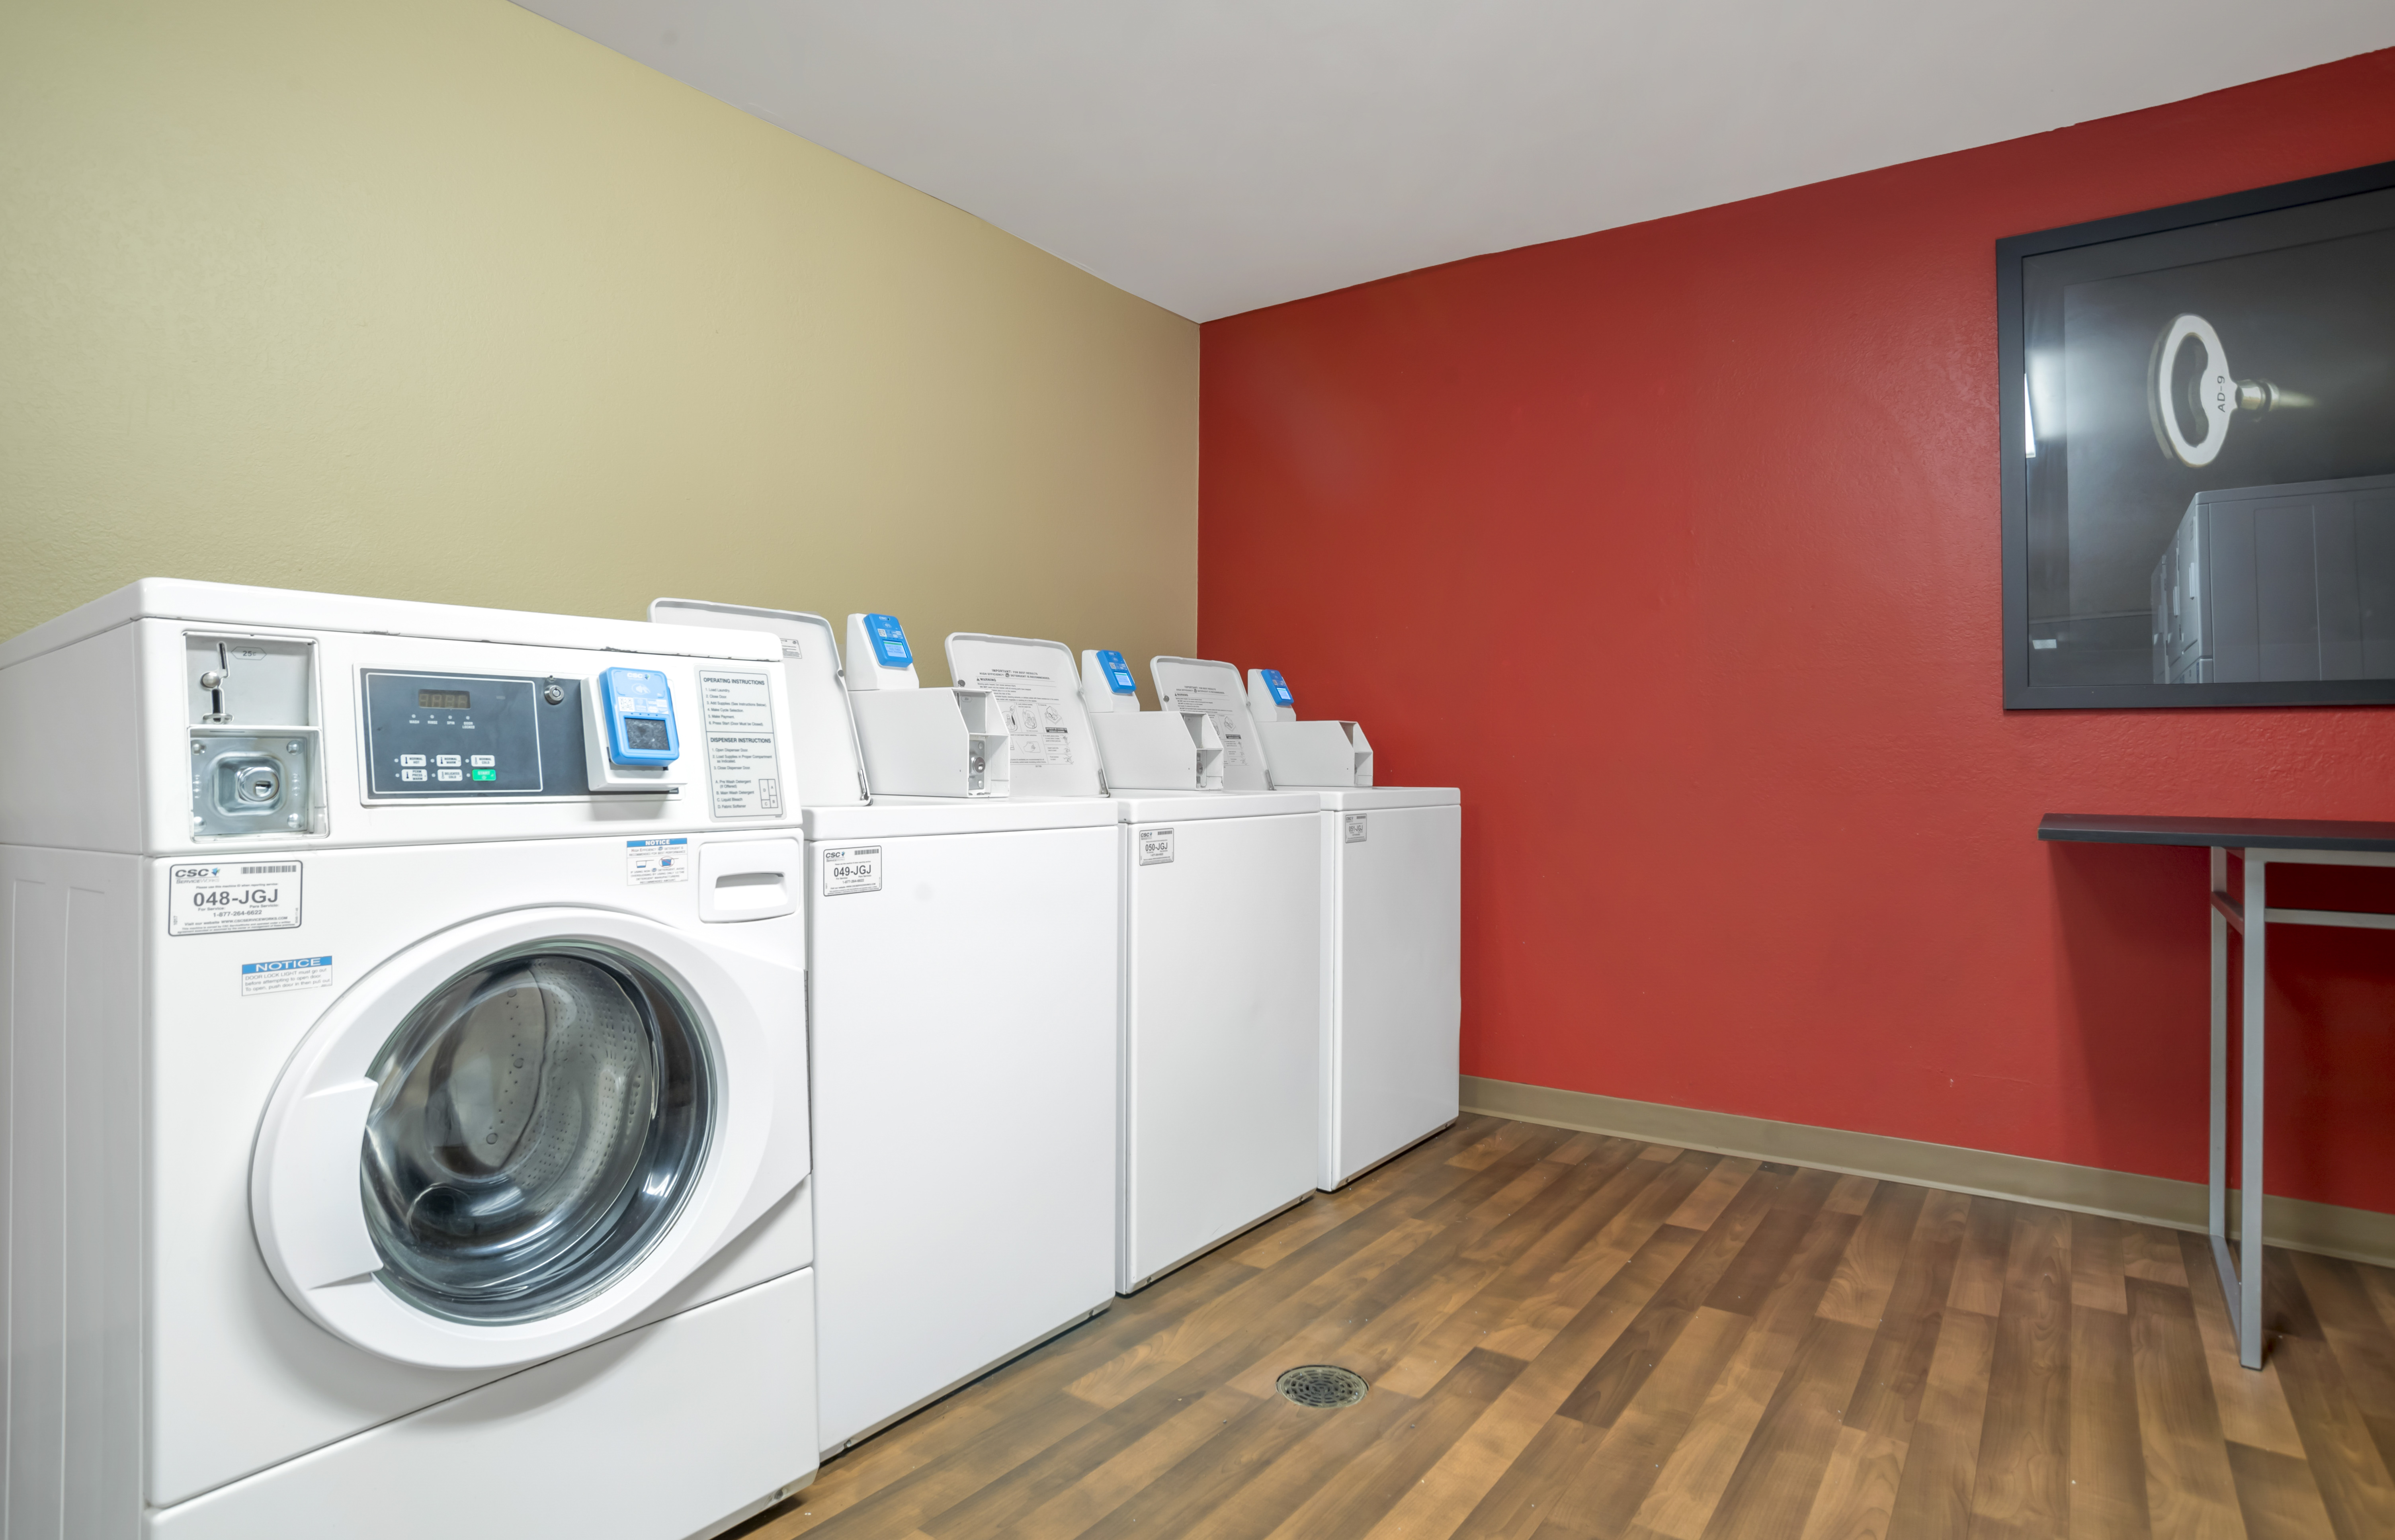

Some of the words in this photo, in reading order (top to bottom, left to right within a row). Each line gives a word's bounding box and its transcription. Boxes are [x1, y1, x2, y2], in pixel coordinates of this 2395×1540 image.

[2217, 375, 2225, 412] AD-9
[1145, 842, 1168, 851] 050-JGJ
[175, 869, 209, 877] CSC
[834, 864, 871, 877] 049-JGJ
[193, 889, 278, 907] 048-JGJ
[256, 958, 321, 971] NOTICE
